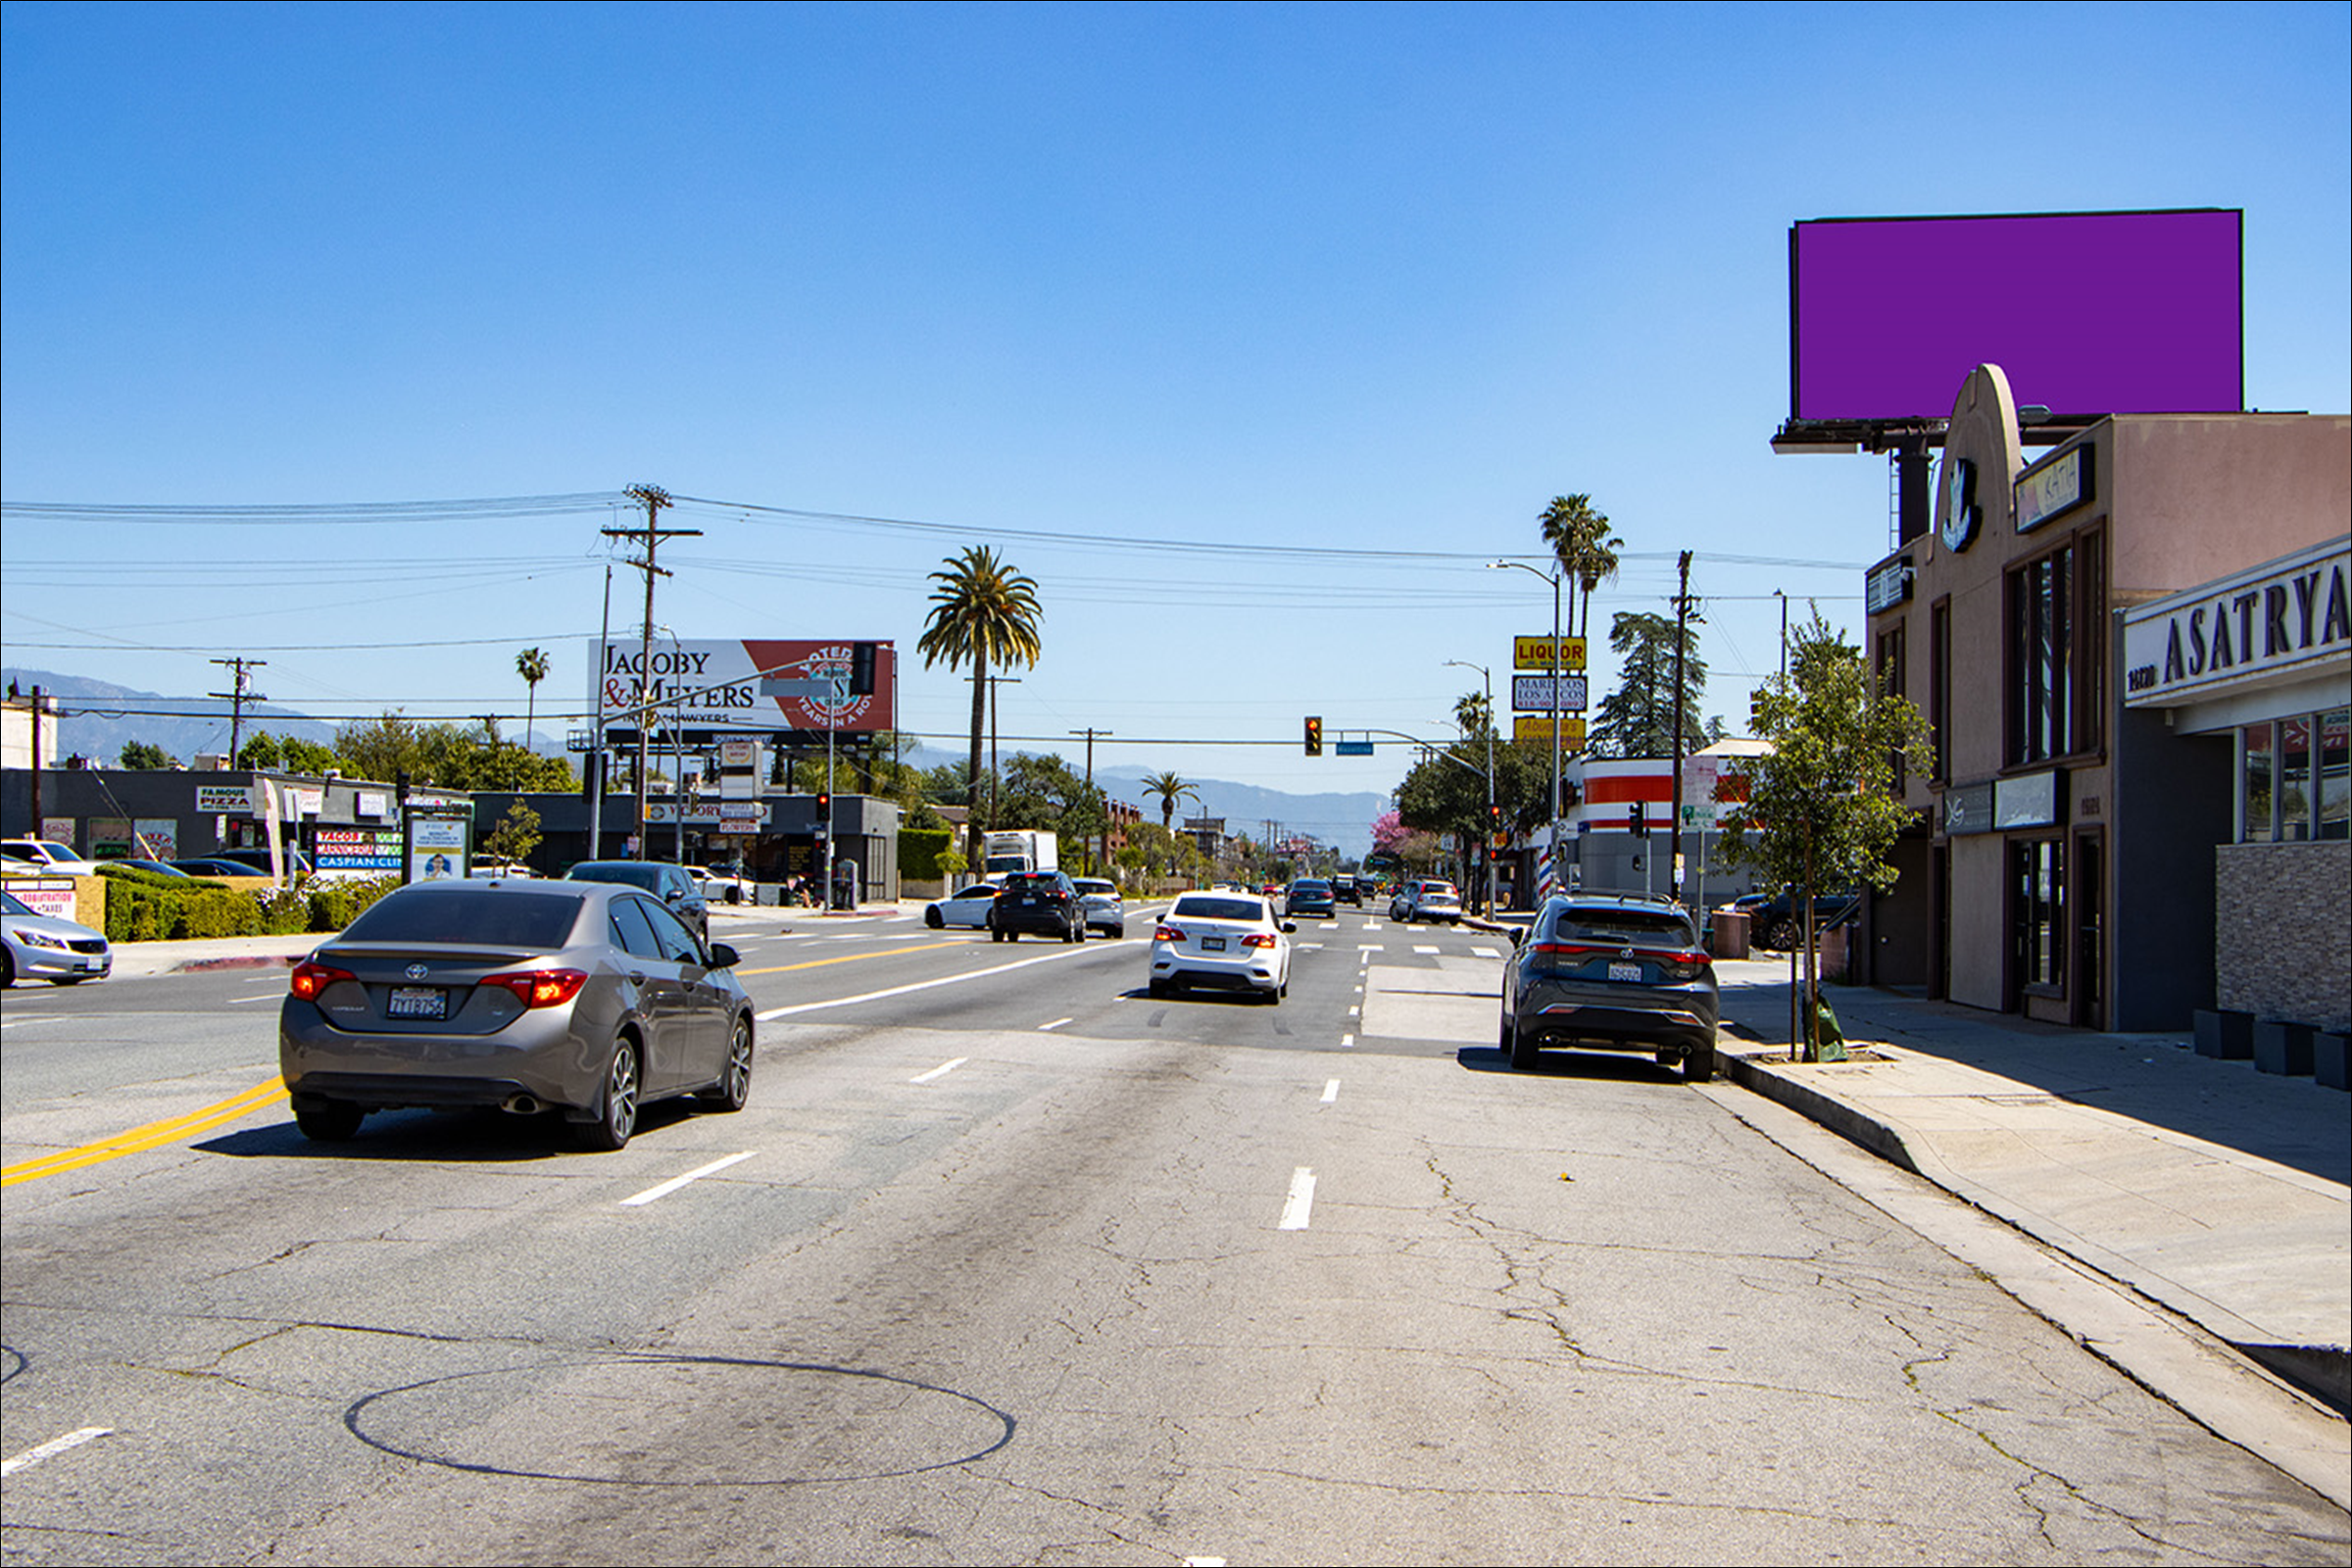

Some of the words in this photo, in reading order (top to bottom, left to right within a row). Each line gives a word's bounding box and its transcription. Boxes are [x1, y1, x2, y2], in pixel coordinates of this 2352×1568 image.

[2163, 564, 2351, 684] ASATRYA
[1518, 645, 1583, 660] LIQUOR
[603, 678, 628, 709] &
[626, 678, 754, 708] MEYERS
[1518, 690, 1541, 700] LOS
[1543, 690, 1585, 700] ACOS
[798, 696, 829, 726] YEARS
[669, 805, 720, 816] VCORY
[319, 832, 359, 841] TACOS
[318, 857, 374, 866] CASPIAN
